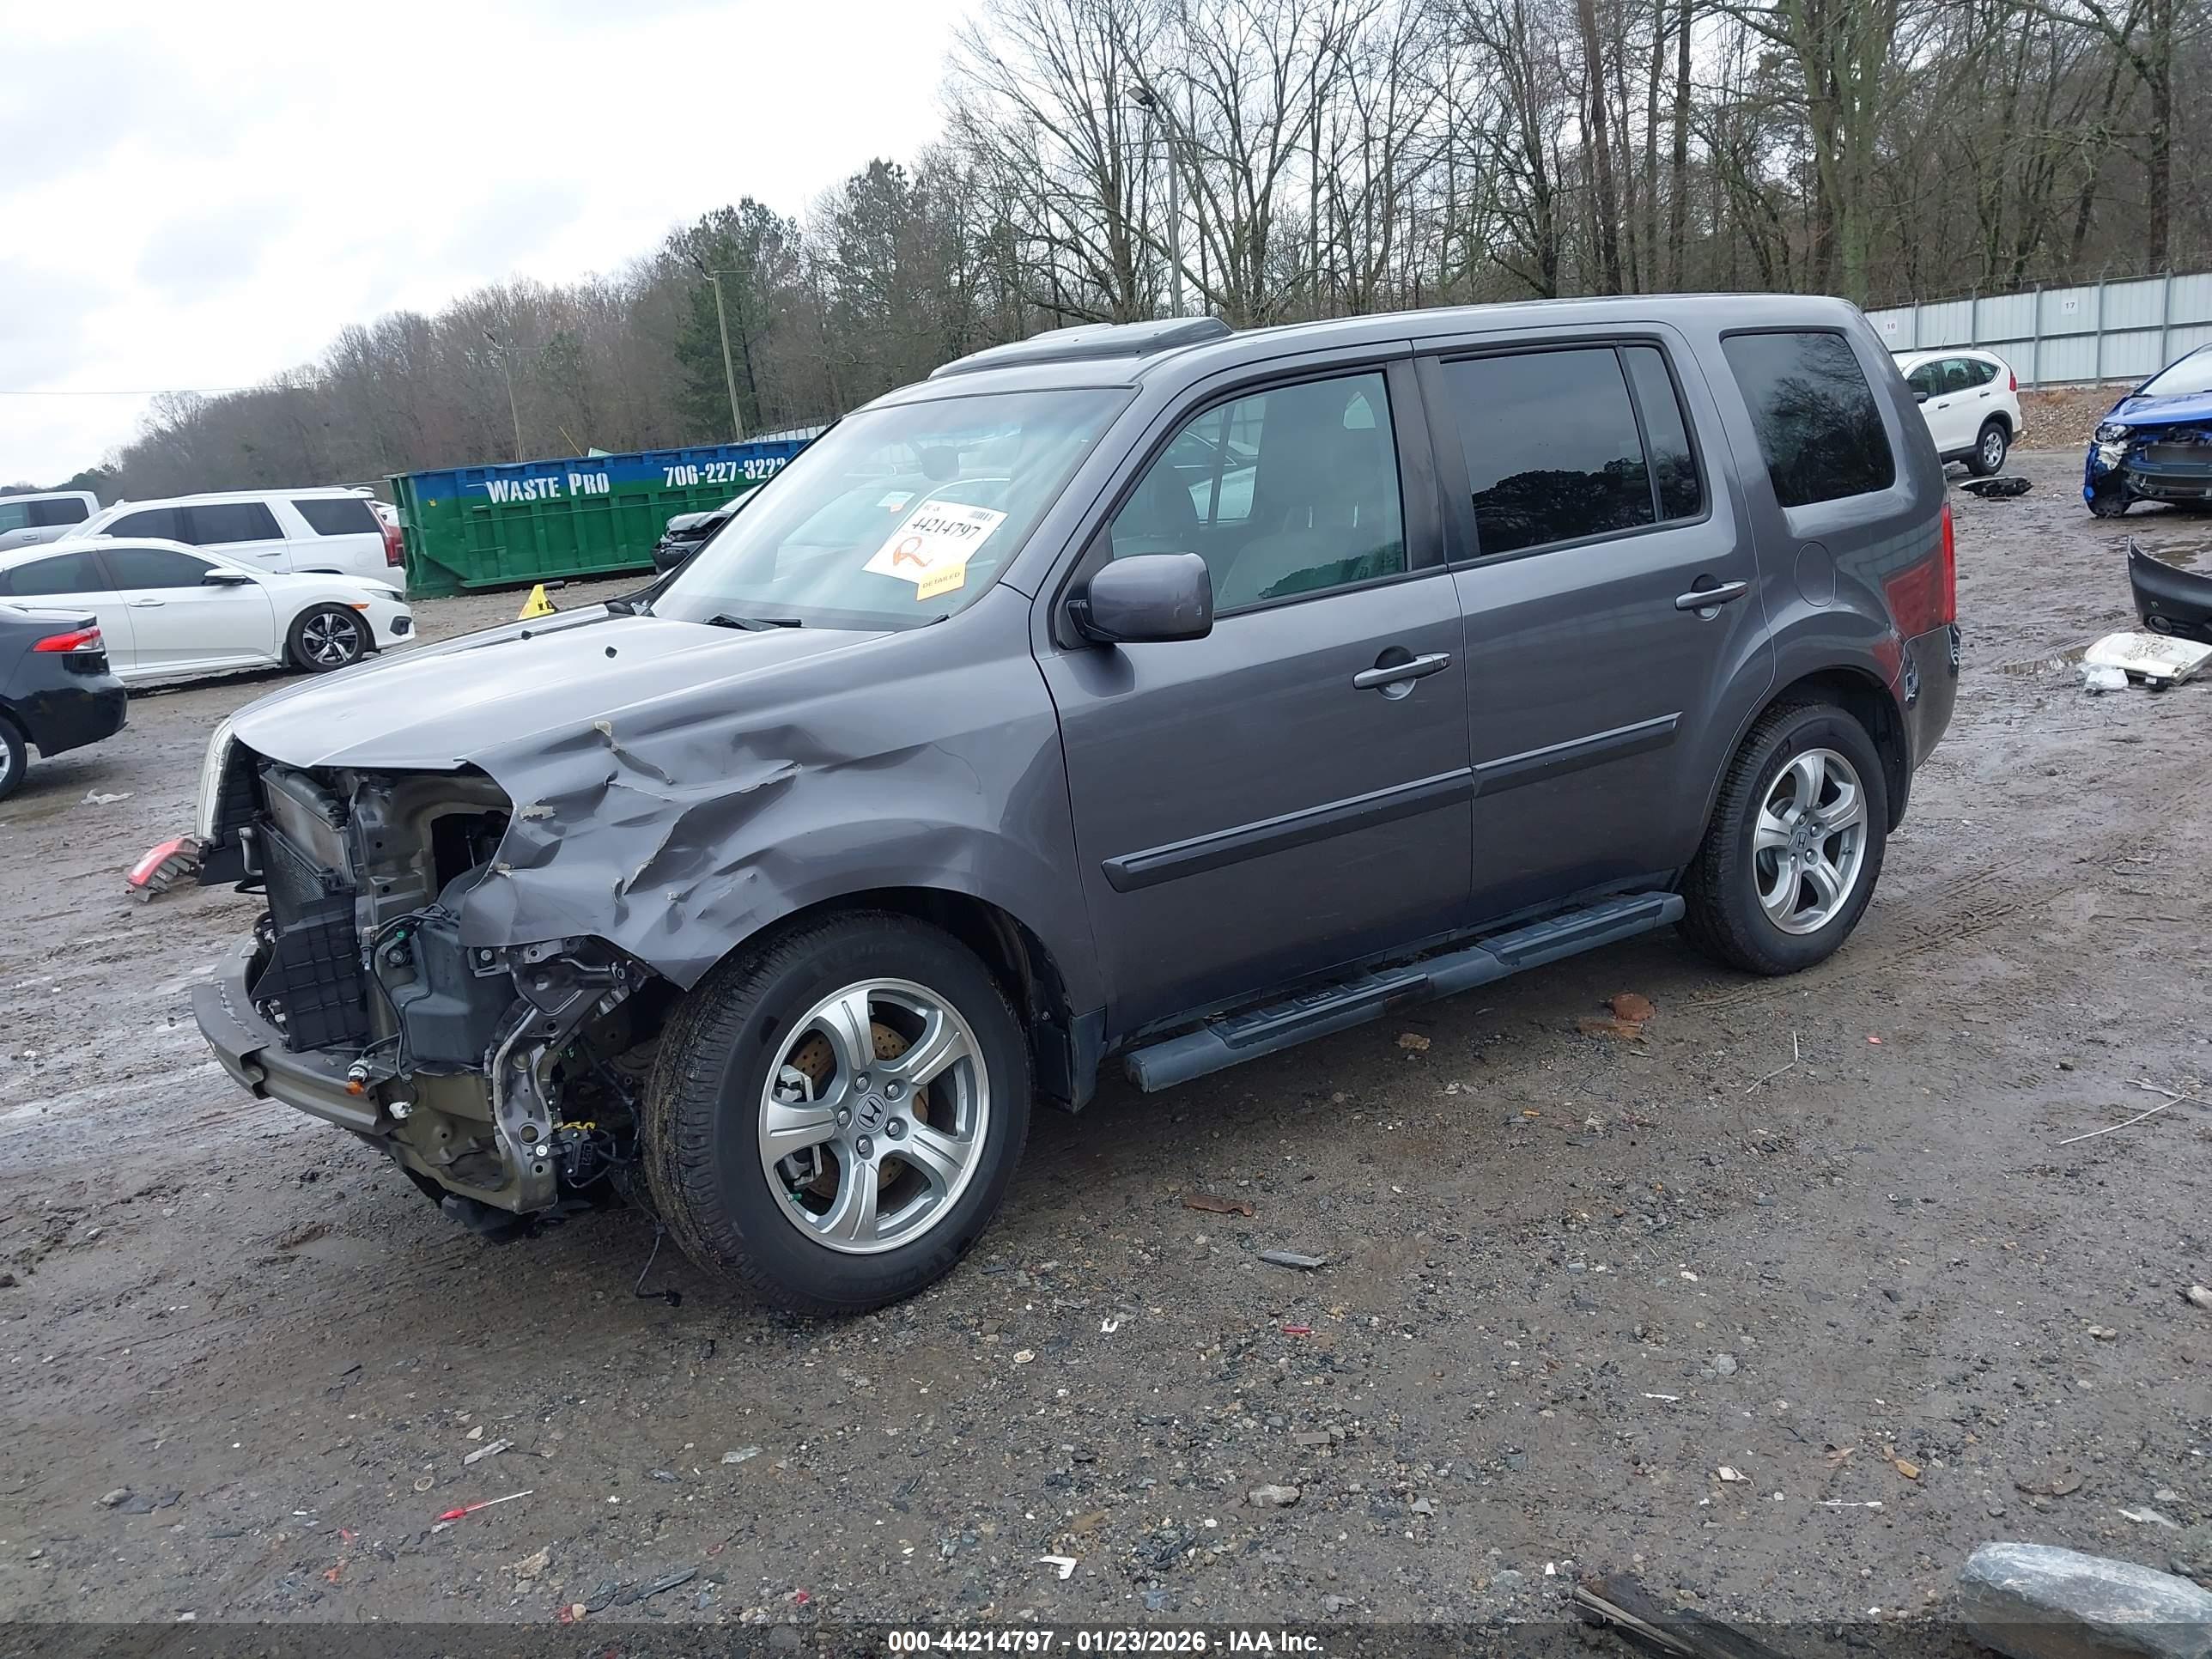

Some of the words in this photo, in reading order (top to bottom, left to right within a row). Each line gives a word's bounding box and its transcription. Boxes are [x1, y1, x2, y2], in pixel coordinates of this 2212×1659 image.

[2065, 301, 2075, 310] 17
[912, 517, 981, 540] 44214797
[922, 571, 961, 589] DETAILED
